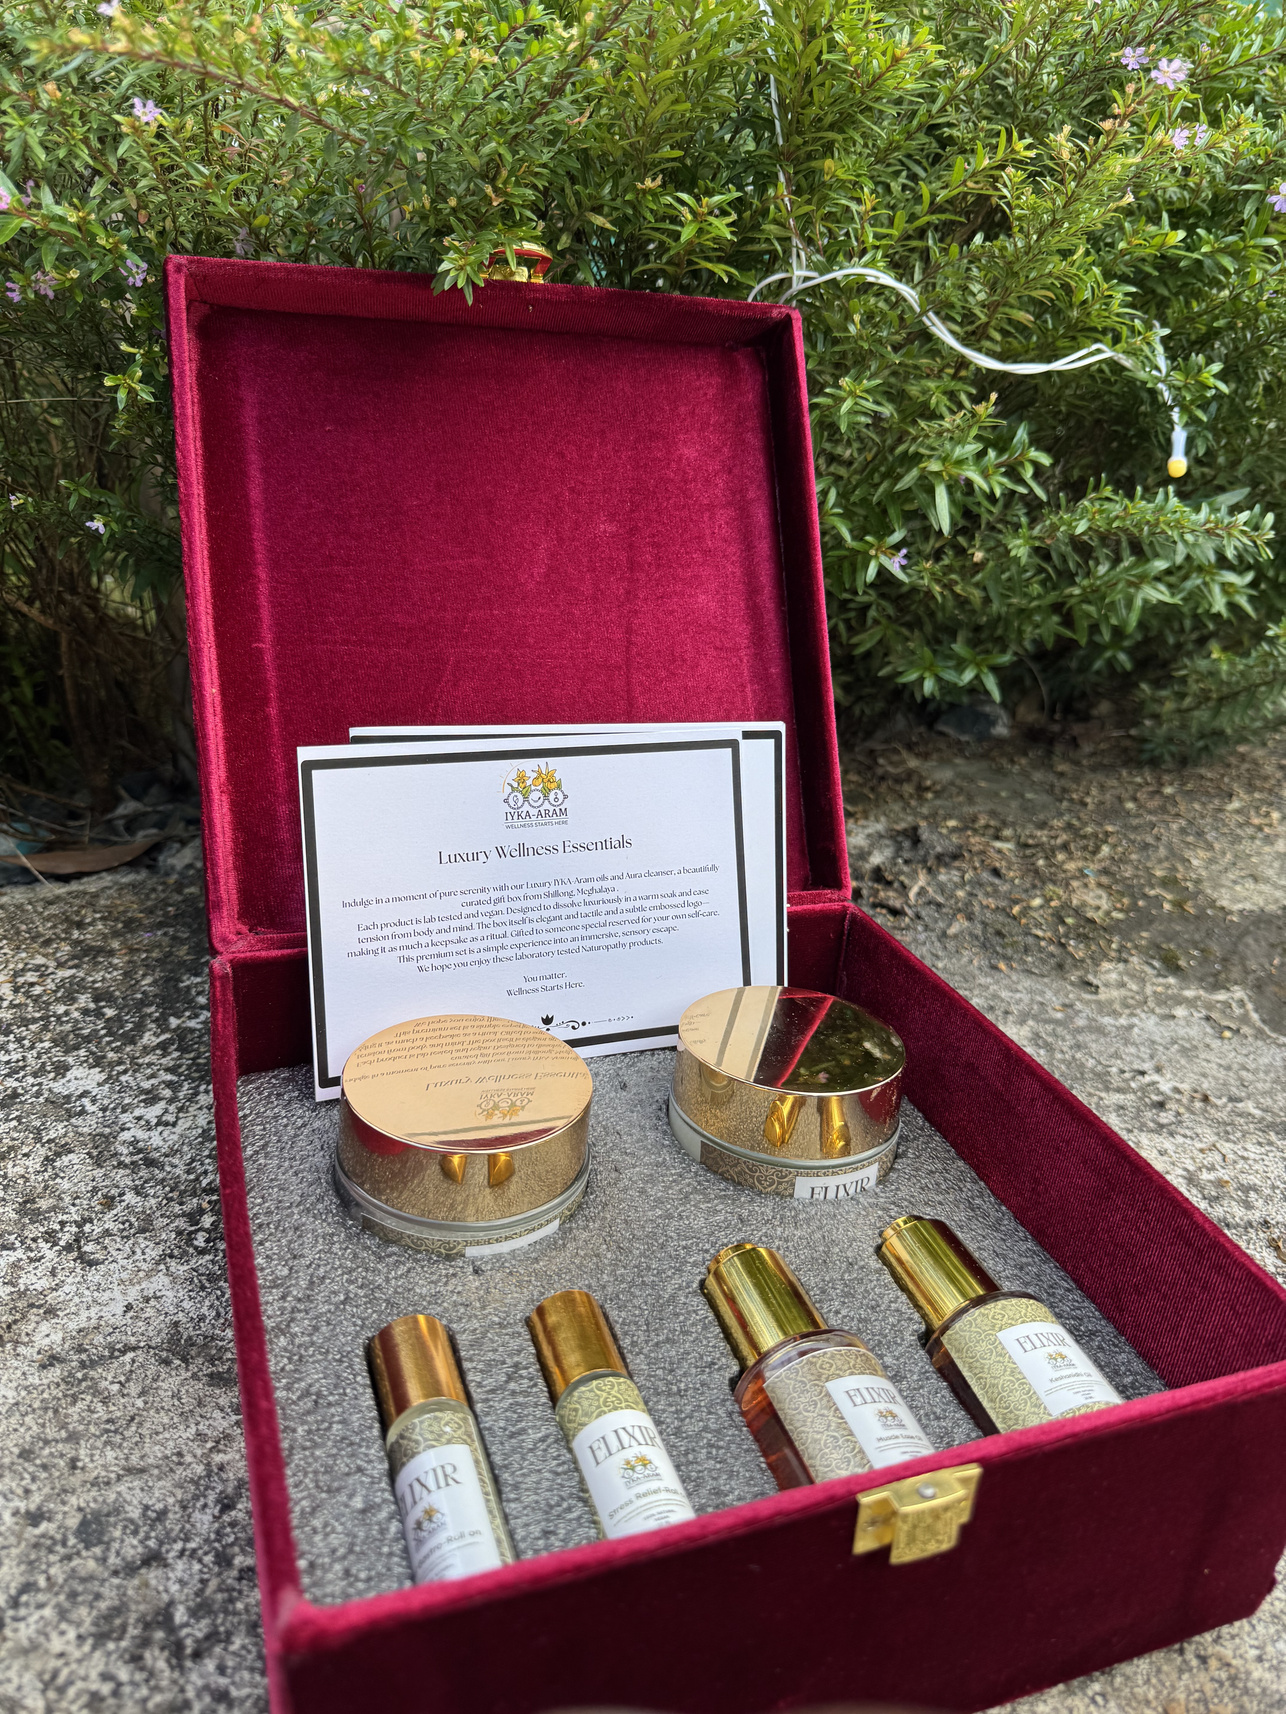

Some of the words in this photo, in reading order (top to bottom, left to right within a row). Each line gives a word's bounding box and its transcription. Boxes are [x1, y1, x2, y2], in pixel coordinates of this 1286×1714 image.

[504, 807, 568, 821] IYKA-ARAM
[438, 850, 492, 865] Luxury
[494, 842, 559, 859] Wellness
[562, 834, 632, 854] Essentials
[342, 899, 374, 908] Indulge
[391, 893, 428, 903] moment
[439, 892, 458, 900] pure
[459, 887, 492, 896] serenity
[526, 881, 552, 891] Luxury
[554, 877, 595, 887] IYKA-Aram
[643, 870, 676, 878] cleanser,
[682, 864, 720, 874] beautifully
[461, 898, 492, 908] curated
[492, 896, 506, 907] gift
[522, 893, 542, 902] from
[543, 890, 576, 902] Shillong,
[576, 886, 616, 897] Meghalaya
[357, 923, 379, 932] Each
[380, 919, 414, 931] product
[437, 913, 463, 923] tested
[463, 912, 480, 920] and
[480, 910, 505, 921] vegan.
[506, 905, 543, 916] Designed
[543, 904, 552, 912] to
[552, 901, 582, 910] dissolve
[583, 896, 623, 908] luxuriously
[660, 891, 677, 899] soak
[678, 889, 692, 897] and
[357, 934, 390, 944] tension
[390, 931, 412, 940] from
[413, 929, 435, 940] body
[435, 926, 452, 935] and
[452, 924, 476, 933] mind.
[492, 920, 508, 928] box
[508, 918, 529, 927] itself
[535, 914, 563, 926] elegant
[564, 912, 579, 920] and
[580, 910, 603, 919] tactile
[604, 908, 618, 916] and
[625, 905, 648, 914] subtle
[648, 900, 686, 912] embossed
[347, 947, 380, 958] making
[398, 942, 423, 951] much
[430, 937, 468, 949] keepsake
[485, 932, 509, 941] ritual.
[510, 929, 535, 938] Gifted
[535, 928, 544, 936] to
[544, 926, 580, 935] someone
[581, 921, 607, 932] special
[608, 917, 640, 927] reserved
[652, 916, 670, 924] your
[687, 910, 720, 919] self-care.
[397, 955, 415, 963] This
[416, 950, 454, 963] premium
[454, 948, 467, 957] set
[482, 944, 509, 956] simple
[509, 939, 552, 951] experience
[553, 937, 569, 945] into
[580, 932, 621, 945] immersive,
[622, 929, 651, 939] sensory
[652, 926, 679, 934] escape.
[416, 964, 430, 973] We
[430, 963, 452, 972] hope
[453, 961, 468, 970] you
[469, 958, 492, 968] enjoy
[492, 955, 514, 964] these
[515, 950, 556, 961] laboratory
[556, 946, 580, 956] tested
[581, 942, 628, 953] Naturopathy
[628, 938, 663, 950] products.
[506, 987, 540, 996] Wellness
[540, 984, 564, 992] Starts
[539, 972, 567, 981] matter.
[1015, 1332, 1071, 1353] ELIXIR
[844, 1386, 902, 1407] ELIXIR
[587, 1424, 663, 1467] ELIXIR
[608, 1498, 633, 1520] Stress
